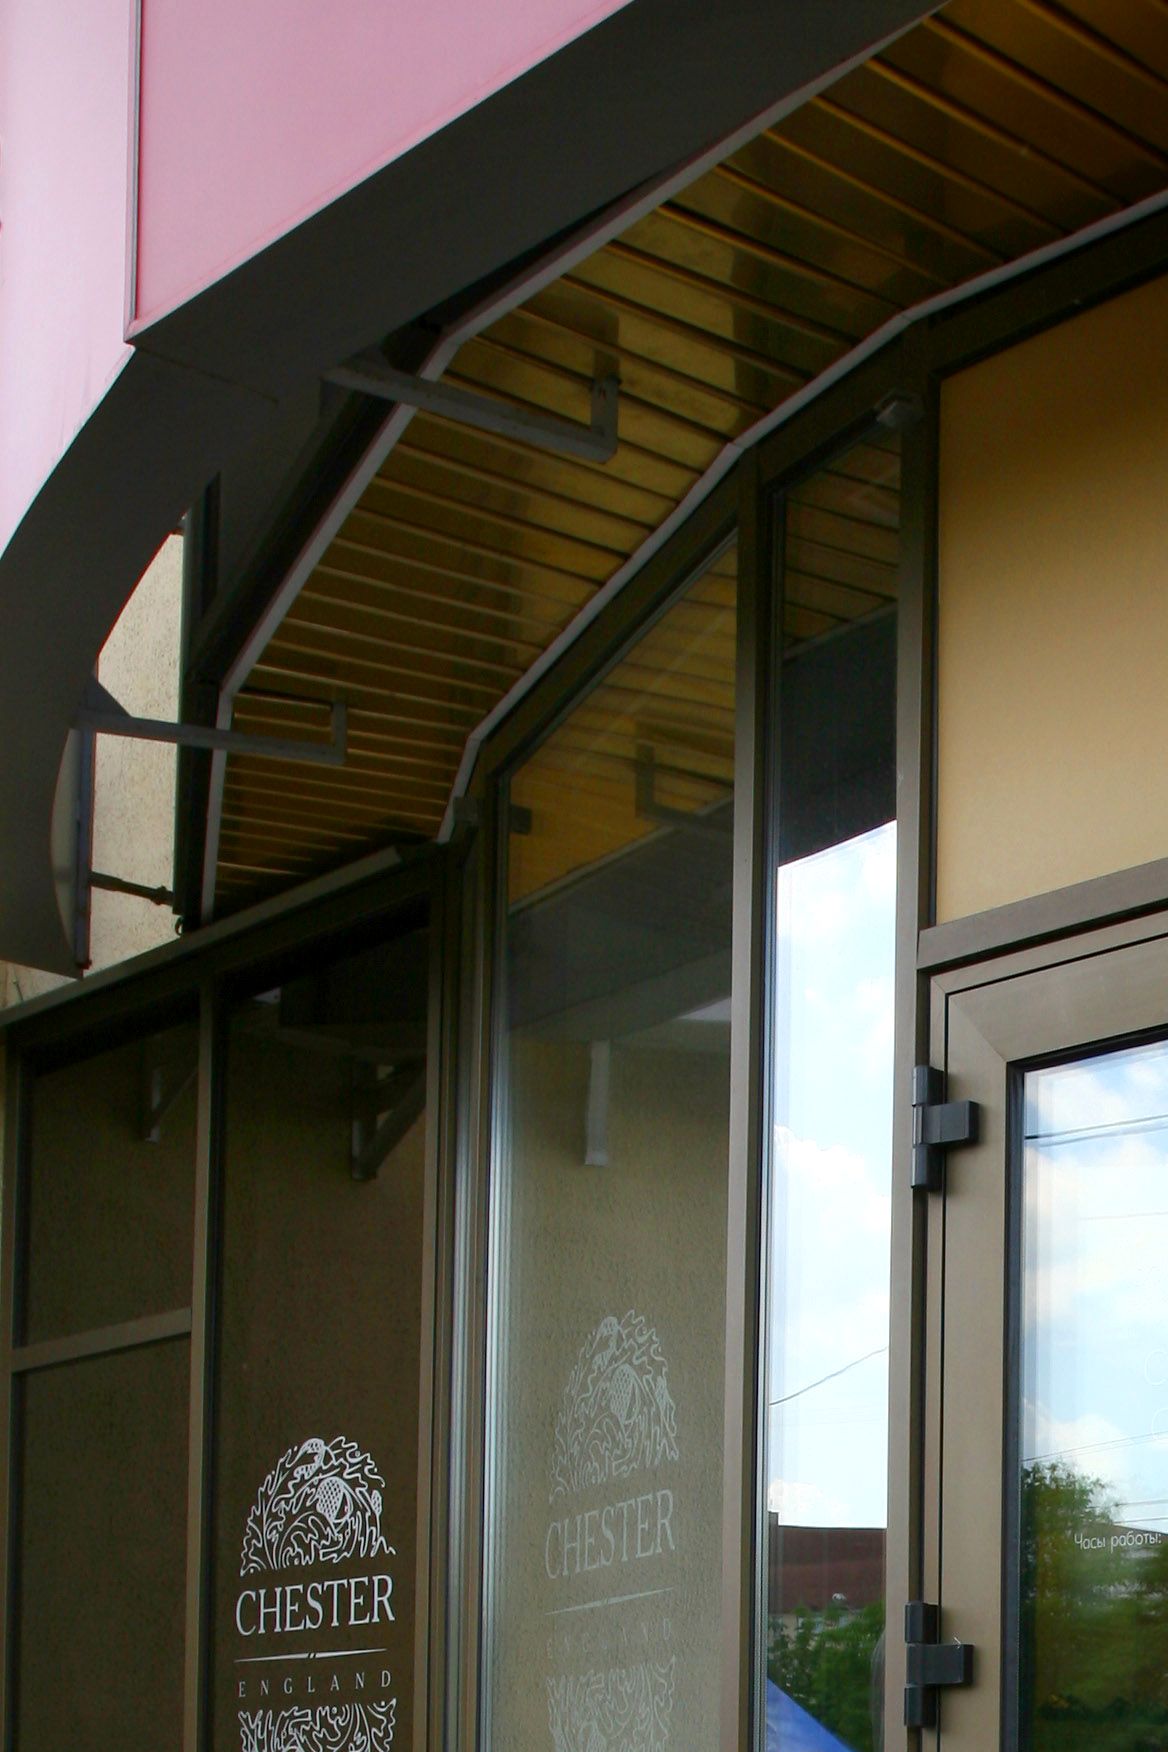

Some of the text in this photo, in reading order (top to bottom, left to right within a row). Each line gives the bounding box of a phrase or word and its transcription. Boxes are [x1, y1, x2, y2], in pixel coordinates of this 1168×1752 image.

[545, 1489, 675, 1579] CHESTER
[1074, 1532, 1106, 1551] Часы
[1111, 1530, 1162, 1554] работы:
[235, 1574, 396, 1637] CHESTER
[238, 1669, 392, 1698] ENGLAND
